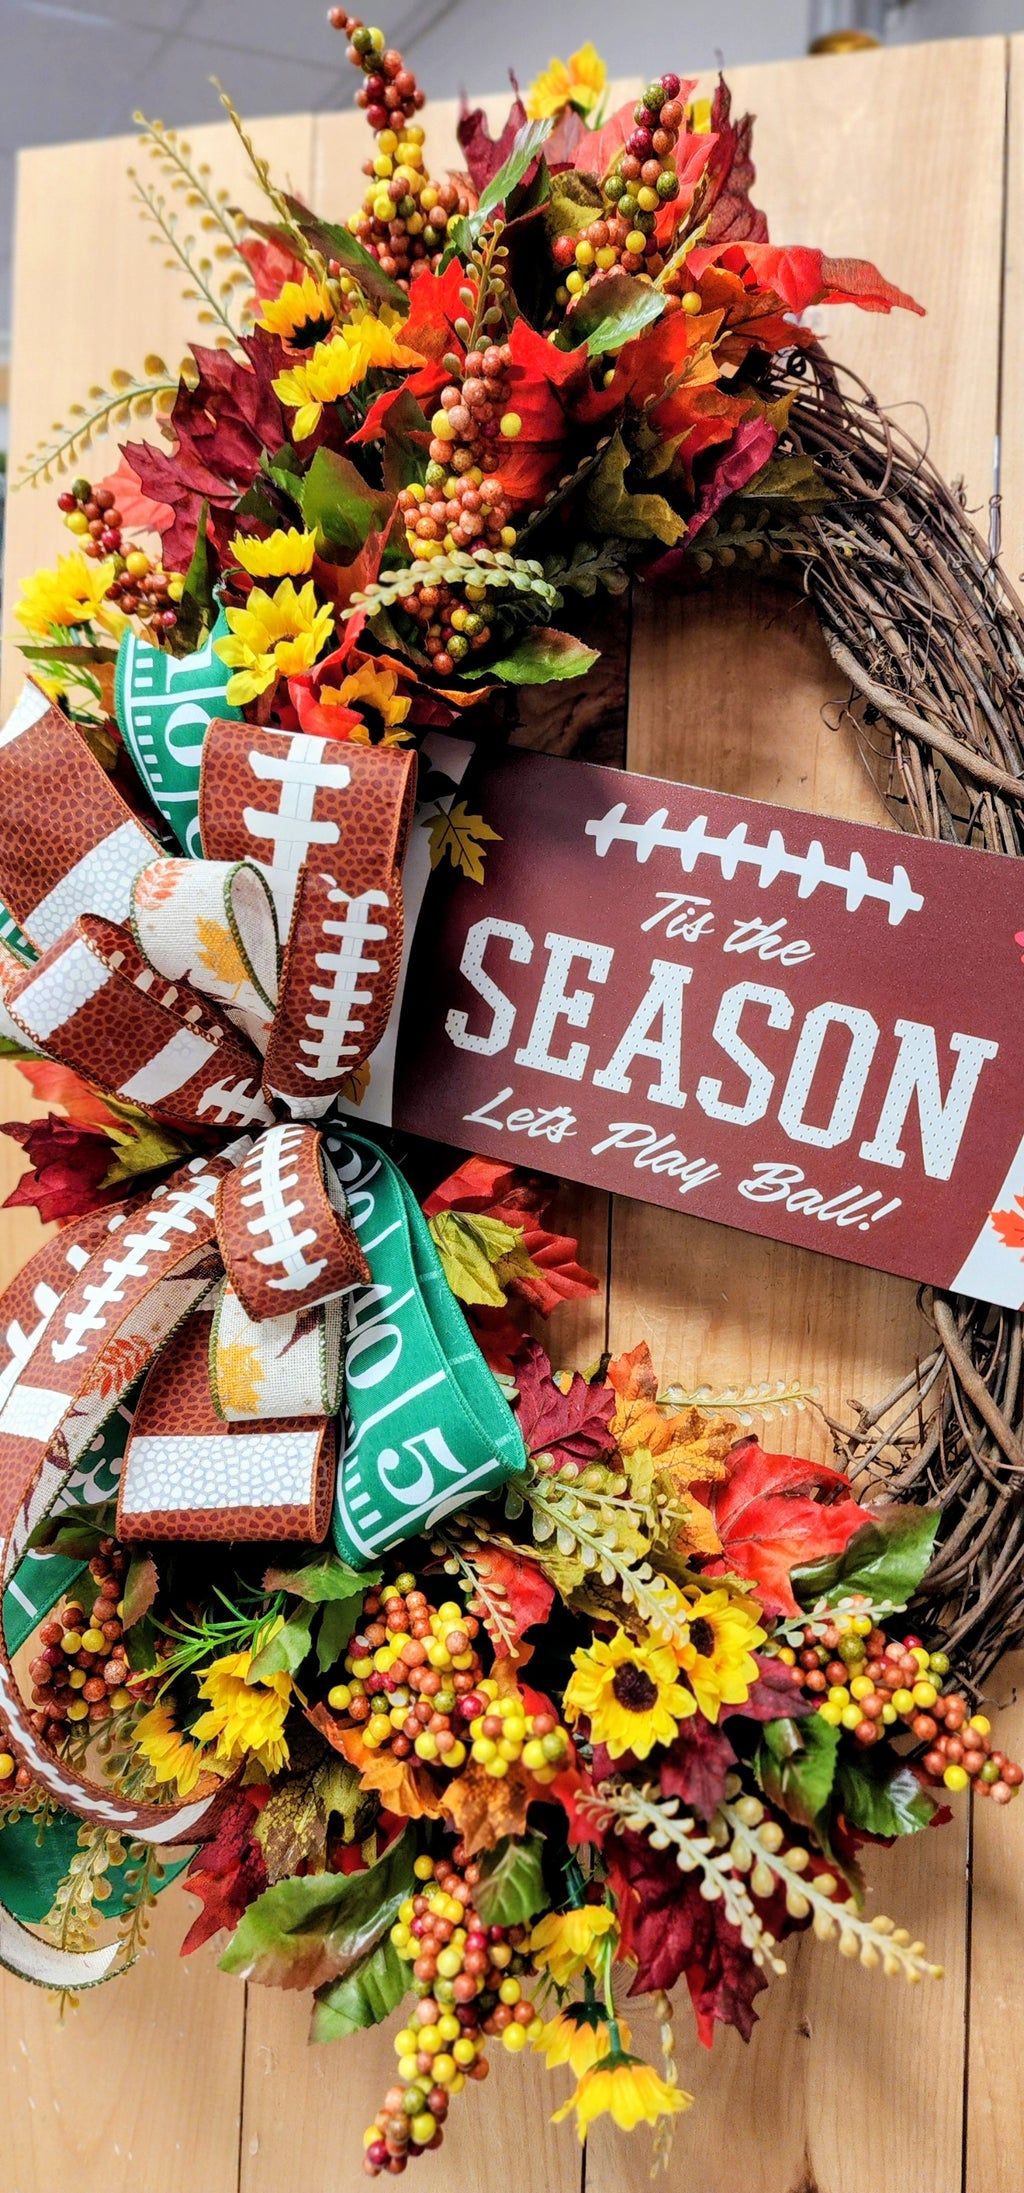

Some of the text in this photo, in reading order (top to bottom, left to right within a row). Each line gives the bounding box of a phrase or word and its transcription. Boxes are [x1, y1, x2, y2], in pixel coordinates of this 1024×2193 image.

[641, 892, 816, 966] Tis the
[445, 917, 999, 1181] SEASON
[591, 1123, 721, 1194] Play
[738, 1163, 903, 1230] Ball!
